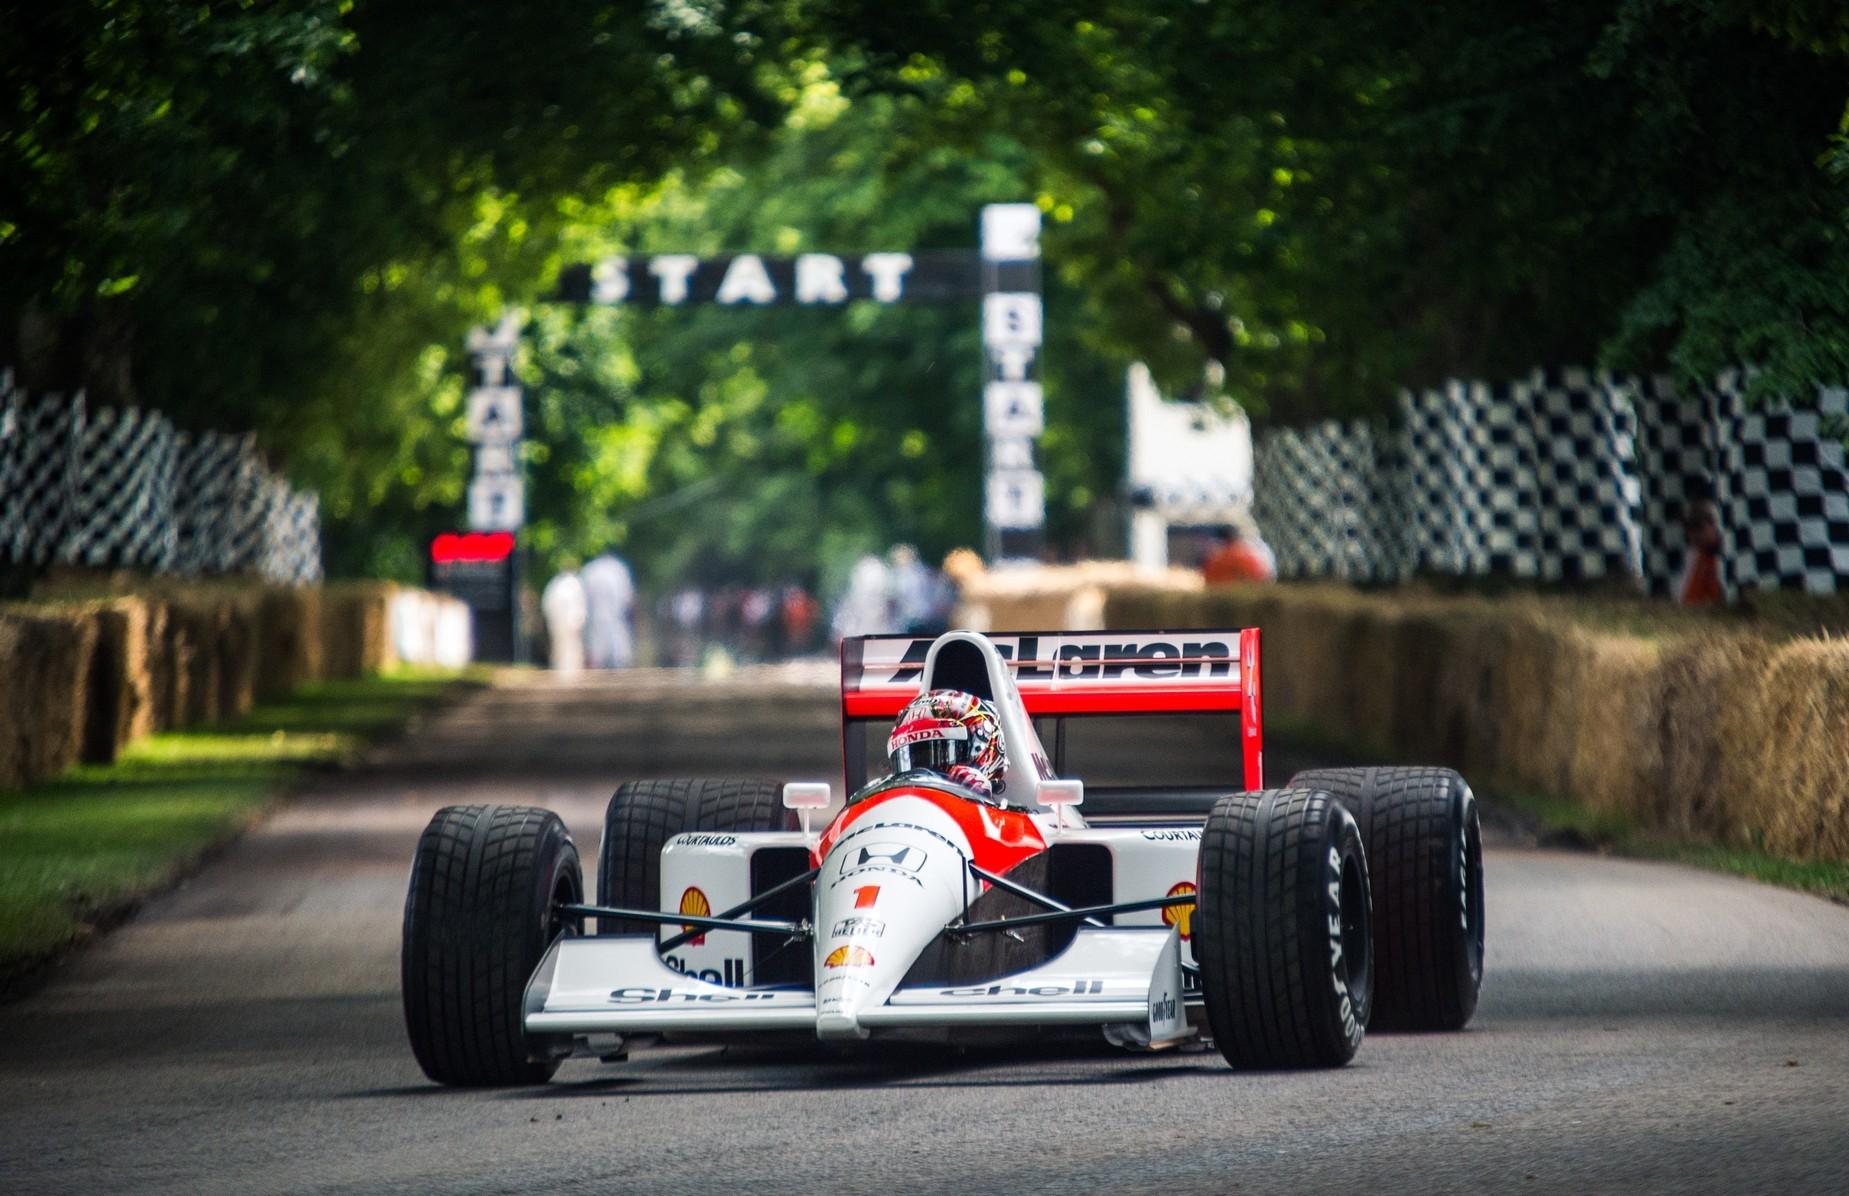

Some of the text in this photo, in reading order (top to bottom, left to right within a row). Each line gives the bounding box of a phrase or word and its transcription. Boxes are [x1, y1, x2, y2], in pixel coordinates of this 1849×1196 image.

[591, 253, 913, 303] START
[891, 729, 945, 750] HONDA
[830, 866, 924, 889] HONDA
[853, 885, 881, 909] 1
